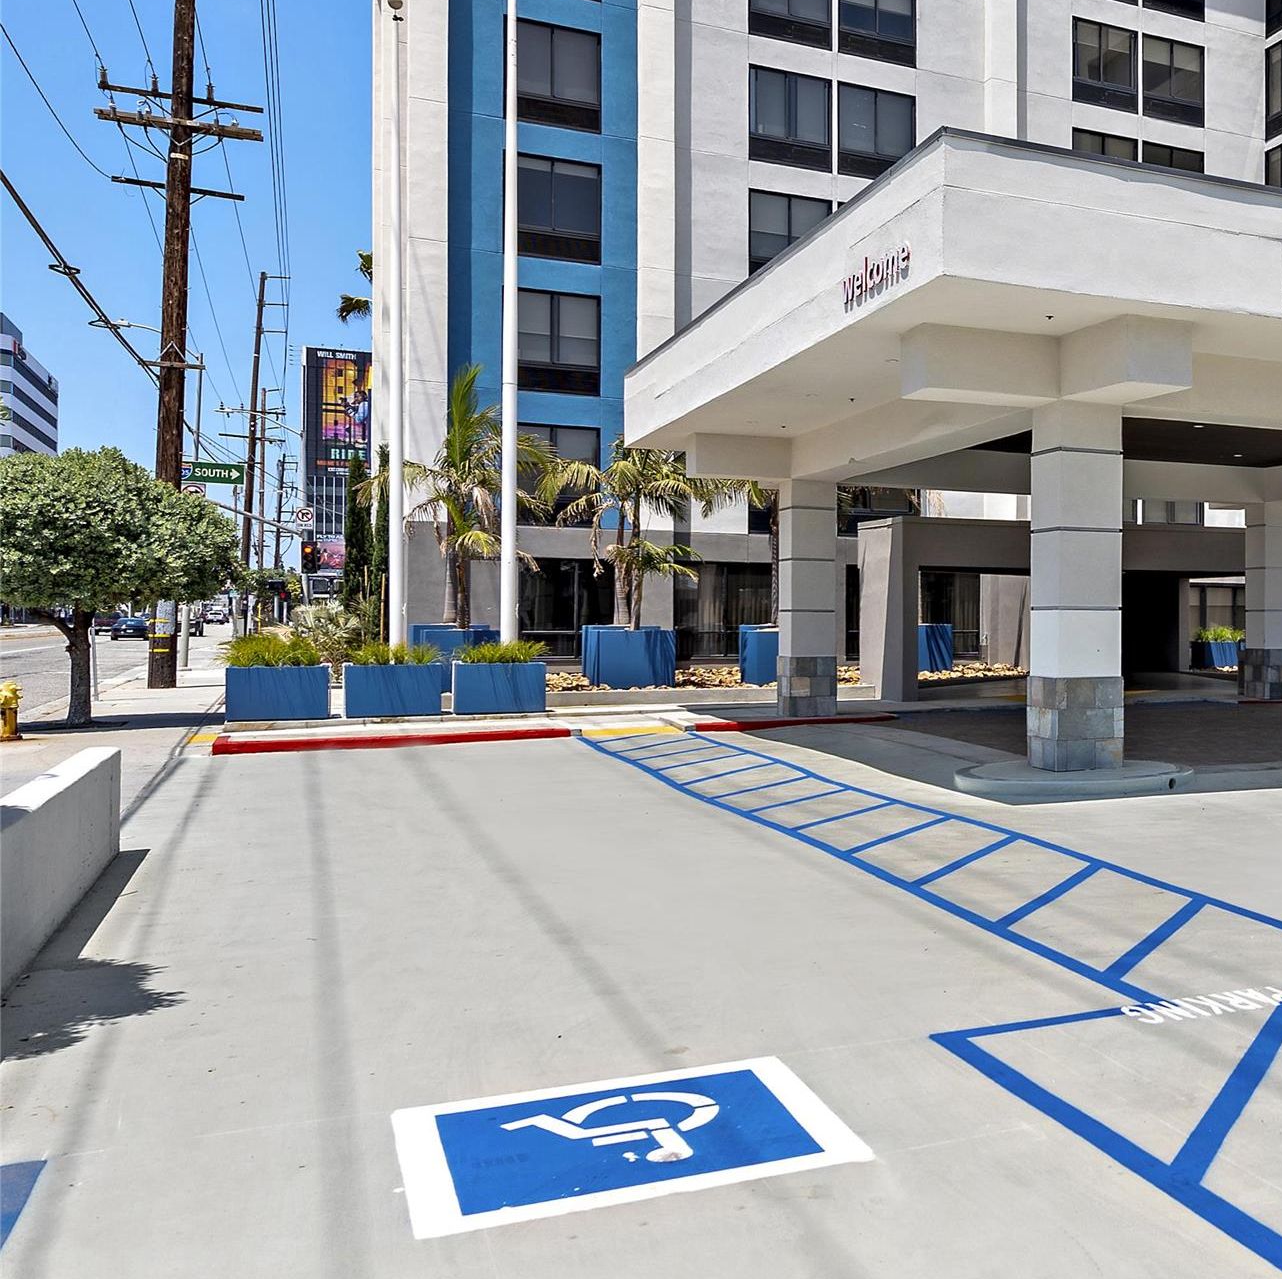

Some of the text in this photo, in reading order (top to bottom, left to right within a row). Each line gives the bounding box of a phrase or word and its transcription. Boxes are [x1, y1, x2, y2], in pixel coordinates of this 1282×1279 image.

[842, 240, 911, 305] welcome
[317, 350, 357, 360] WILL SMITH
[194, 467, 229, 478] SOUTH
